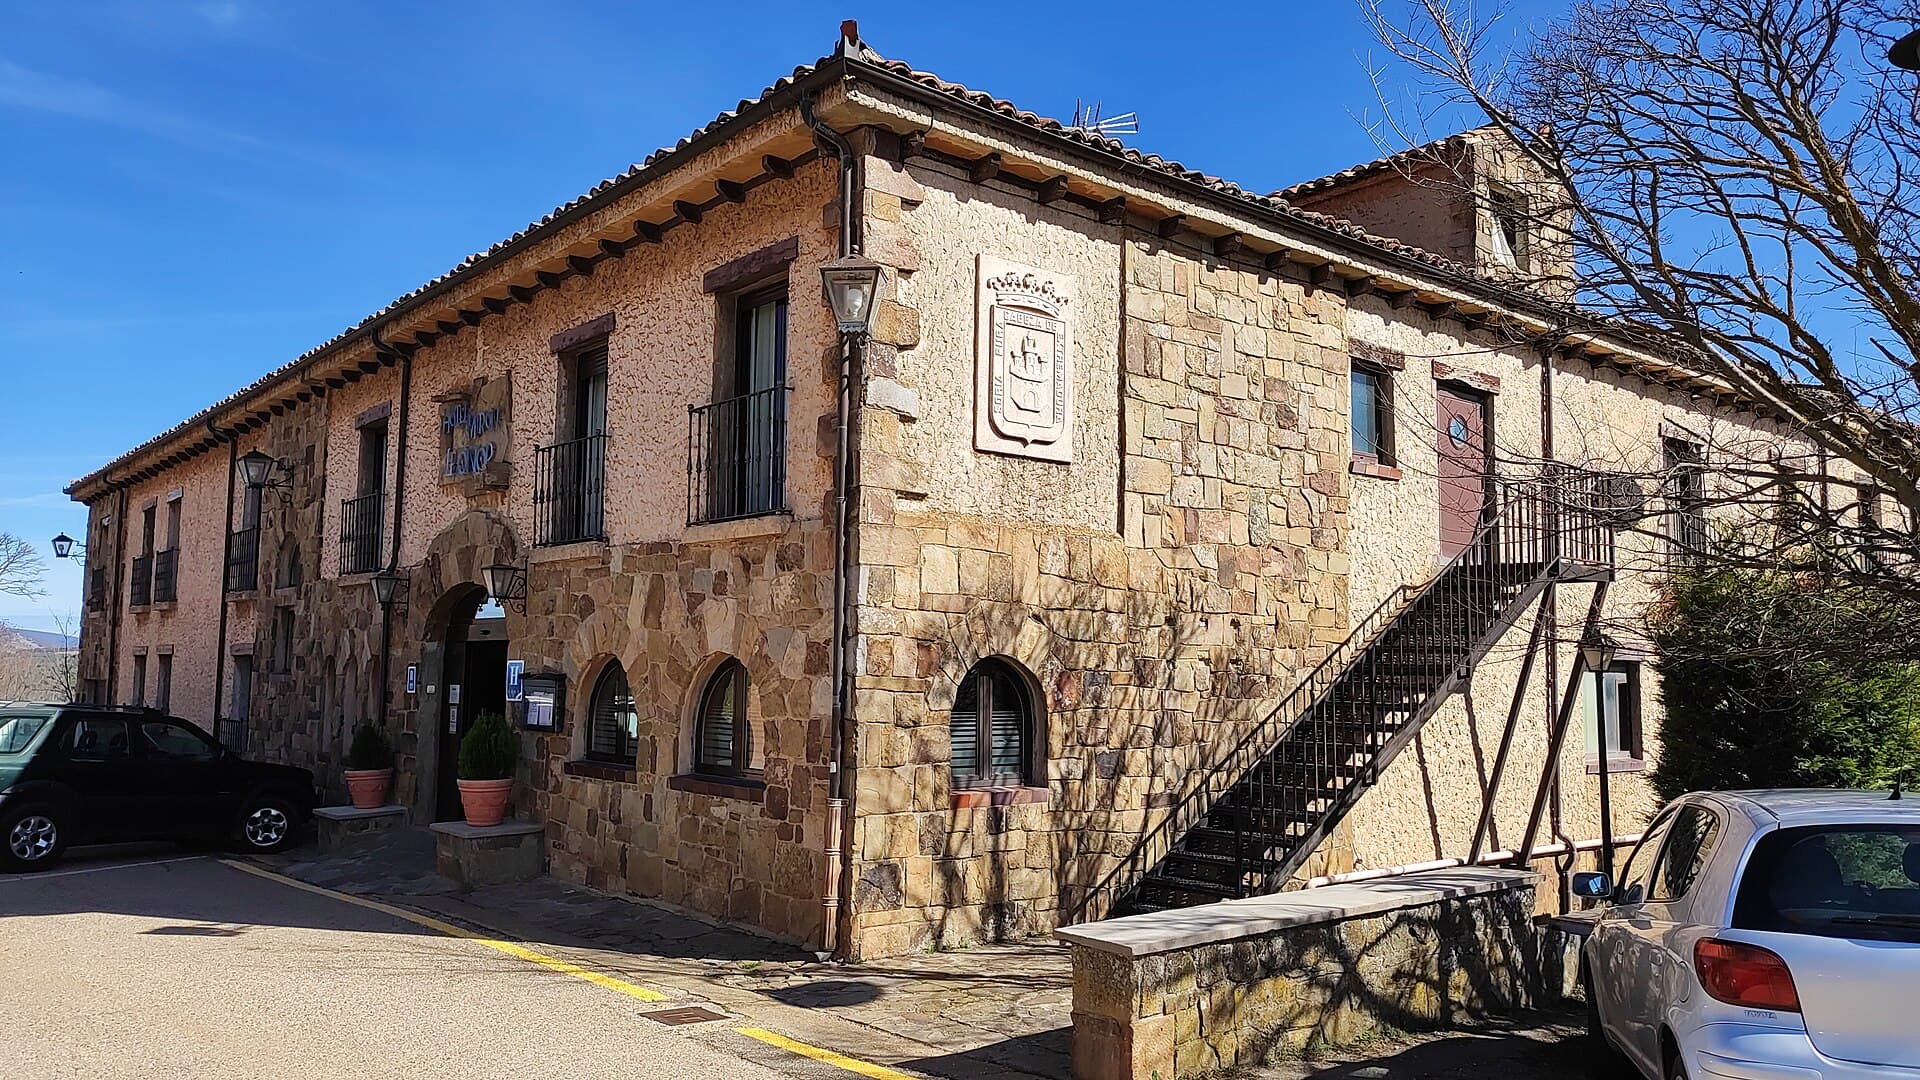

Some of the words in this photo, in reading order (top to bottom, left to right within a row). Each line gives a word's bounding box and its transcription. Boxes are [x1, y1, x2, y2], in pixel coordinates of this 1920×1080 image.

[1004, 311, 1042, 328] CABEZA
[1046, 320, 1057, 332] DE
[994, 376, 1004, 414] SORIA
[1744, 1009, 1777, 1020] TOYOTA
